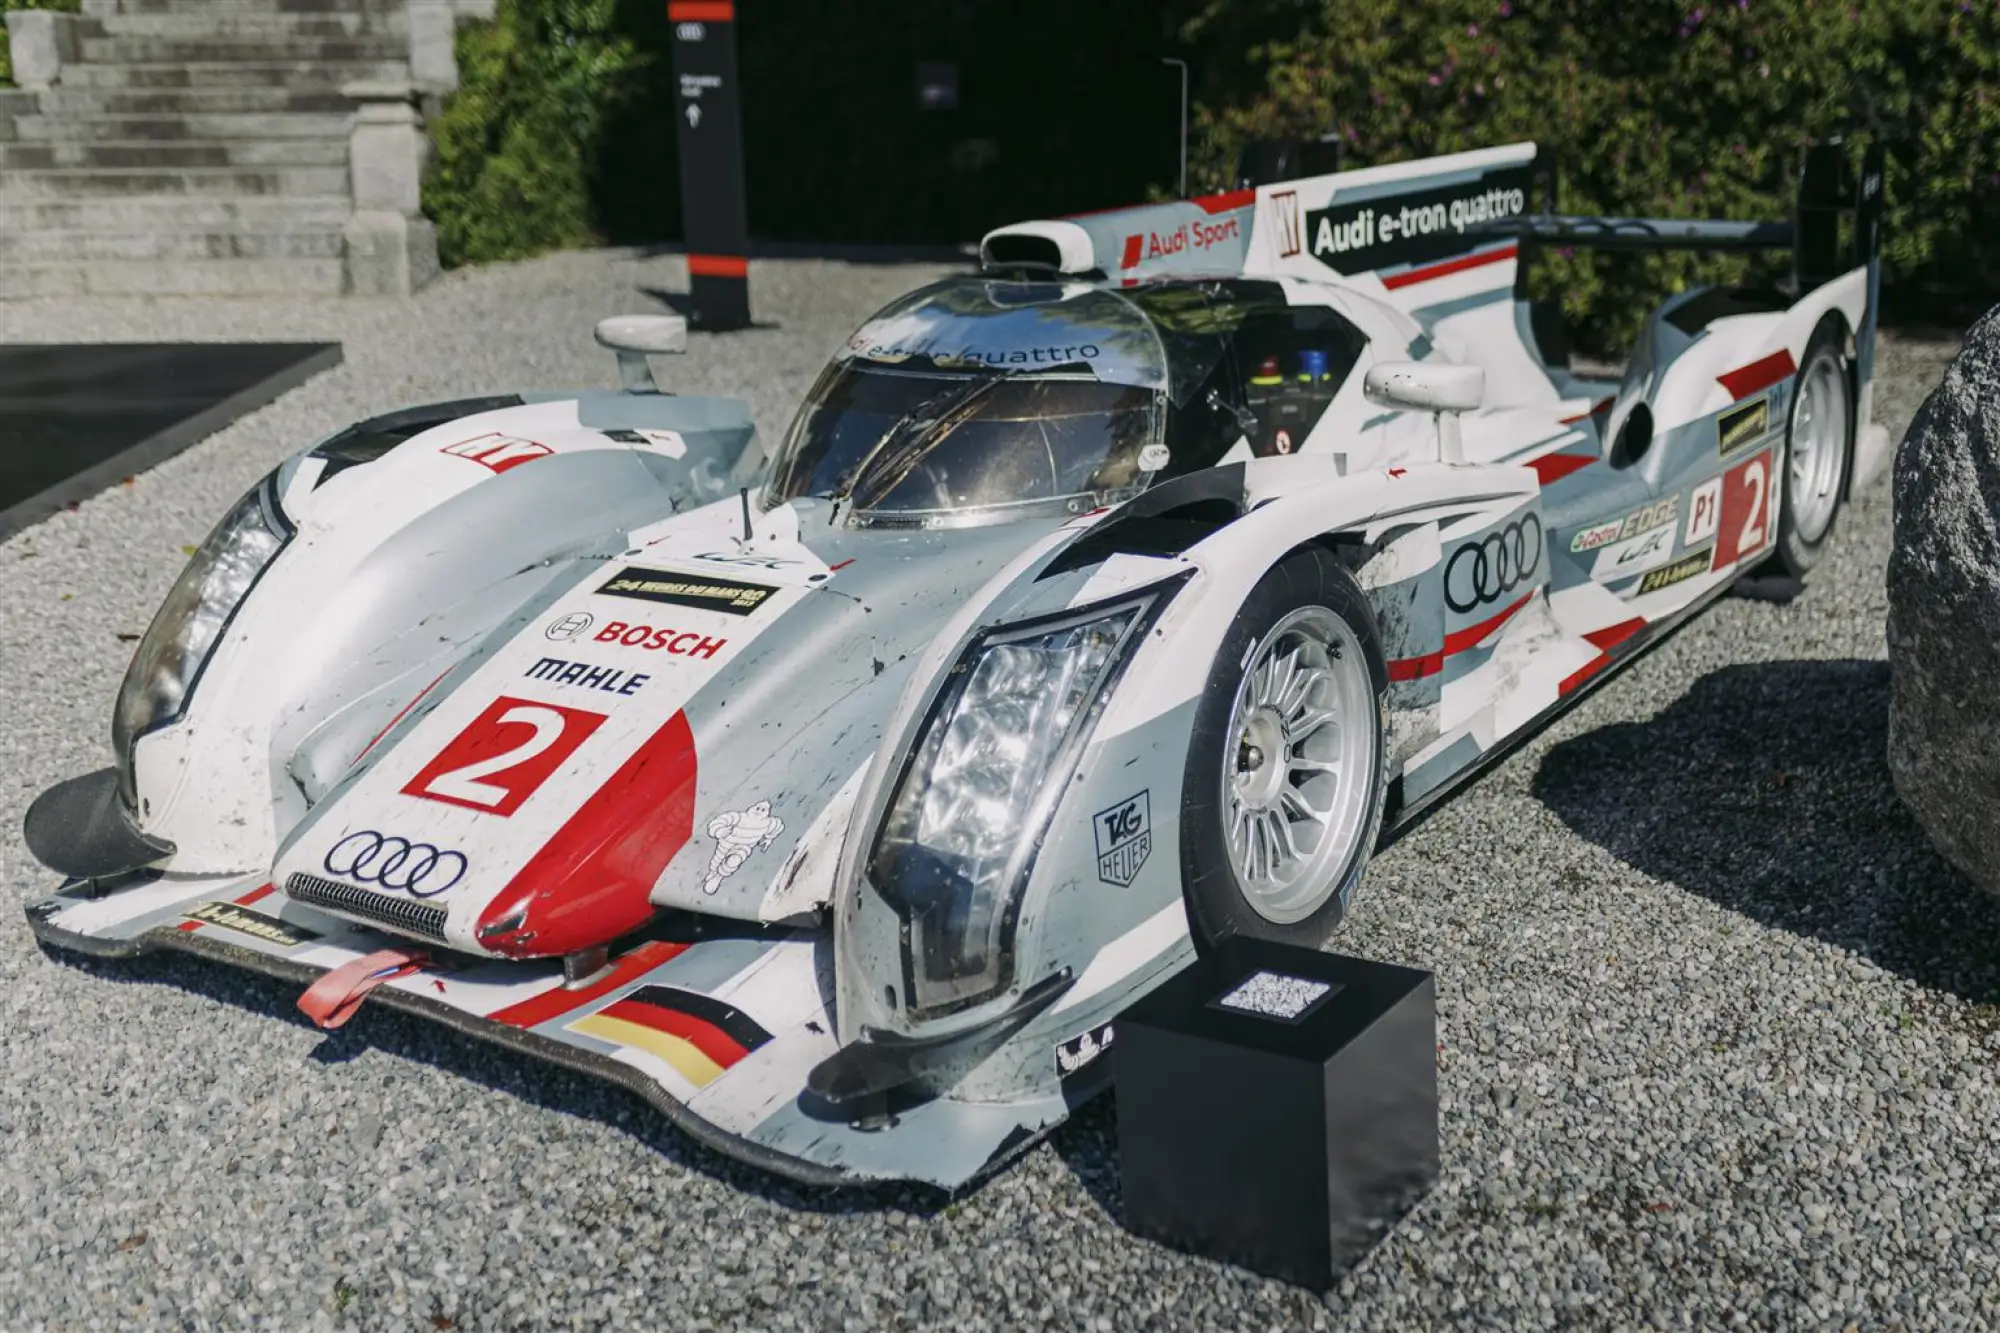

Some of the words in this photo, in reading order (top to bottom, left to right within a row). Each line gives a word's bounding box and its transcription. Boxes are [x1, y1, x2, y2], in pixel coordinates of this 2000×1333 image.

[1148, 224, 1189, 259] Audi
[1191, 215, 1239, 250] Sport
[1314, 209, 1374, 256] Audi
[1378, 203, 1446, 242] e-tron
[1450, 188, 1524, 234] quattro
[1620, 493, 1679, 540] EDGE
[1693, 491, 1716, 534] P1
[1737, 460, 1765, 555] 2
[605, 579, 643, 592] 24
[593, 621, 728, 660] BOSCH
[524, 657, 651, 696] MAHLE
[424, 706, 566, 808] 2
[1103, 802, 1142, 846] TAG
[1102, 836, 1149, 881] HEUER
